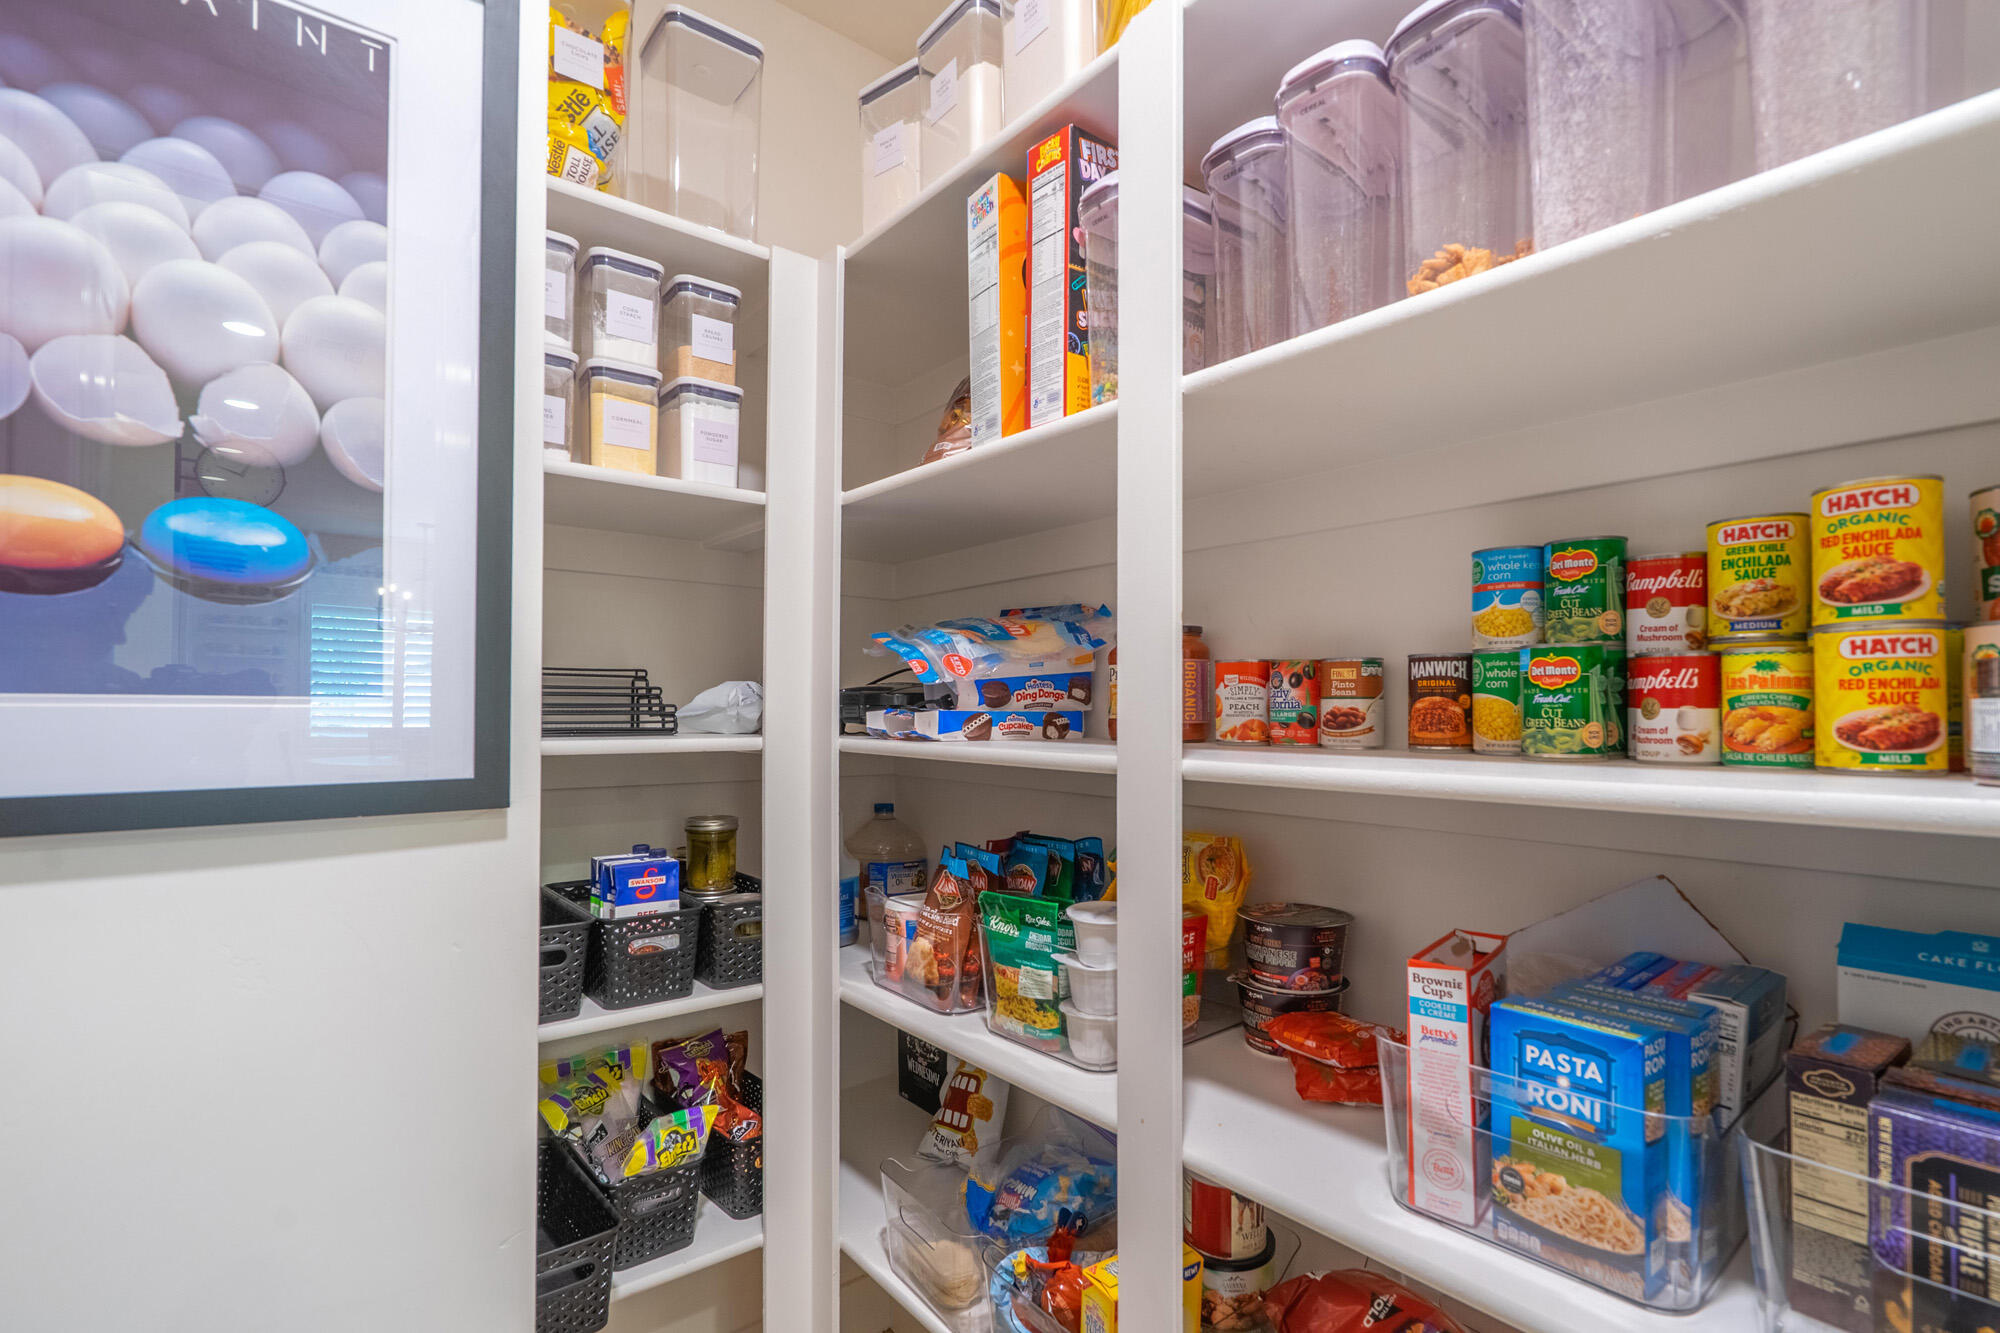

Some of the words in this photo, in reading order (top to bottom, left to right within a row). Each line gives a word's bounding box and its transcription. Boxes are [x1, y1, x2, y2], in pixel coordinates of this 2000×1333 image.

[1827, 487, 1911, 513] HATCH
[1827, 512, 1912, 534] ORGANIC
[1723, 522, 1790, 543] HATCH
[1820, 534, 1841, 549] RED
[1842, 527, 1923, 545] ENCHILADA
[1726, 545, 1756, 556] GREEN
[1758, 543, 1786, 553] CHILE
[1841, 542, 1895, 560] SAUCE
[1487, 560, 1521, 571] whole
[1564, 558, 1594, 569] Monte
[1721, 554, 1792, 571] ENCHILADA
[1487, 572, 1511, 581] corn
[1734, 567, 1777, 581] SAUCE
[1560, 599, 1580, 609] CUT
[1851, 605, 1885, 616] MILD
[1571, 607, 1603, 617] BEANS
[1639, 624, 1668, 632] Cream
[1668, 624, 1679, 632] of
[1733, 621, 1778, 630] MEDIUM
[1636, 634, 1684, 642] Mushroom
[1849, 637, 1933, 656] HATCH
[1410, 660, 1468, 681] MANWICH
[1485, 668, 1518, 678] whole
[1531, 666, 1545, 676] Del
[1545, 665, 1577, 676] Monte
[1848, 660, 1934, 677] ORGANIC
[1417, 679, 1457, 687] ORIGINAL
[1485, 680, 1508, 688] corn
[1627, 667, 1699, 694] ampbell's
[1838, 678, 1866, 691] RED
[1015, 690, 1038, 703] Ding
[1038, 689, 1065, 702] Dongs
[1184, 661, 1197, 721] ORGANIC
[1229, 685, 1260, 697] SIMPLY
[1331, 688, 1357, 696] Beans
[1867, 691, 1921, 706] SAUCE
[1229, 703, 1260, 711] PEACH
[1541, 707, 1563, 718] CUT
[998, 722, 1034, 731] Cupcakes
[1525, 717, 1552, 728] GREEN
[1554, 717, 1586, 728] BEANS
[1658, 726, 1669, 735] of
[1878, 754, 1912, 764] MILD
[630, 876, 665, 887] SWANSON
[988, 914, 1020, 938] Knorr
[1917, 951, 1967, 968] CAKE
[1412, 972, 1464, 990] Brownie
[1422, 984, 1454, 1000] Cups
[1418, 999, 1457, 1012] COOKIES
[1420, 1024, 1458, 1040] Betty's
[906, 1053, 941, 1087] WEDNESDAY
[1525, 1044, 1604, 1084] PASTA
[1526, 1079, 1602, 1123] RONI
[931, 1126, 967, 1148] TERIYAKI
[1532, 1128, 1564, 1148] OLIVE
[1566, 1139, 1585, 1154] OIL
[1527, 1137, 1569, 1159] ITALIAN
